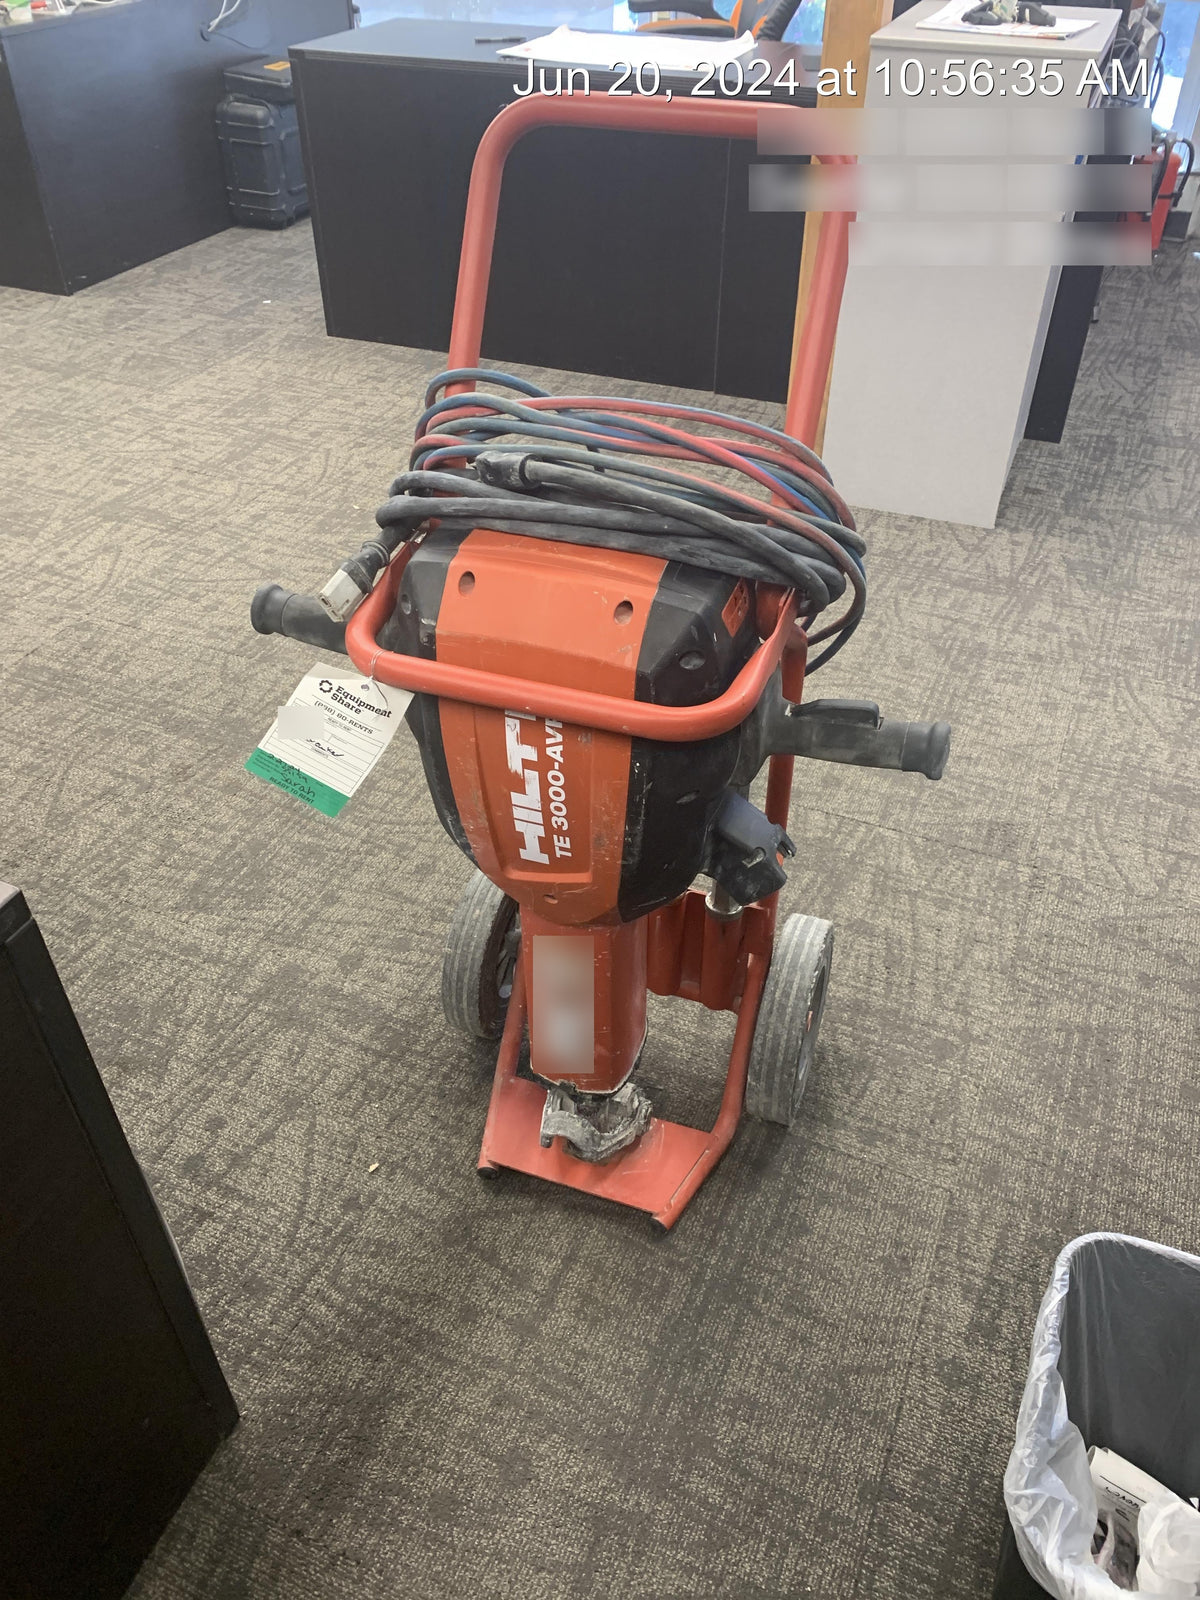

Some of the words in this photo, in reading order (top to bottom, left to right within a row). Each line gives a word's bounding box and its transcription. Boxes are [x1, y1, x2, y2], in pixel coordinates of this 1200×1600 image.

[330, 692, 362, 715] Share
[335, 685, 392, 718] Equipment
[269, 776, 289, 790] READY
[298, 793, 315, 804] RENT
[553, 834, 573, 859] TE
